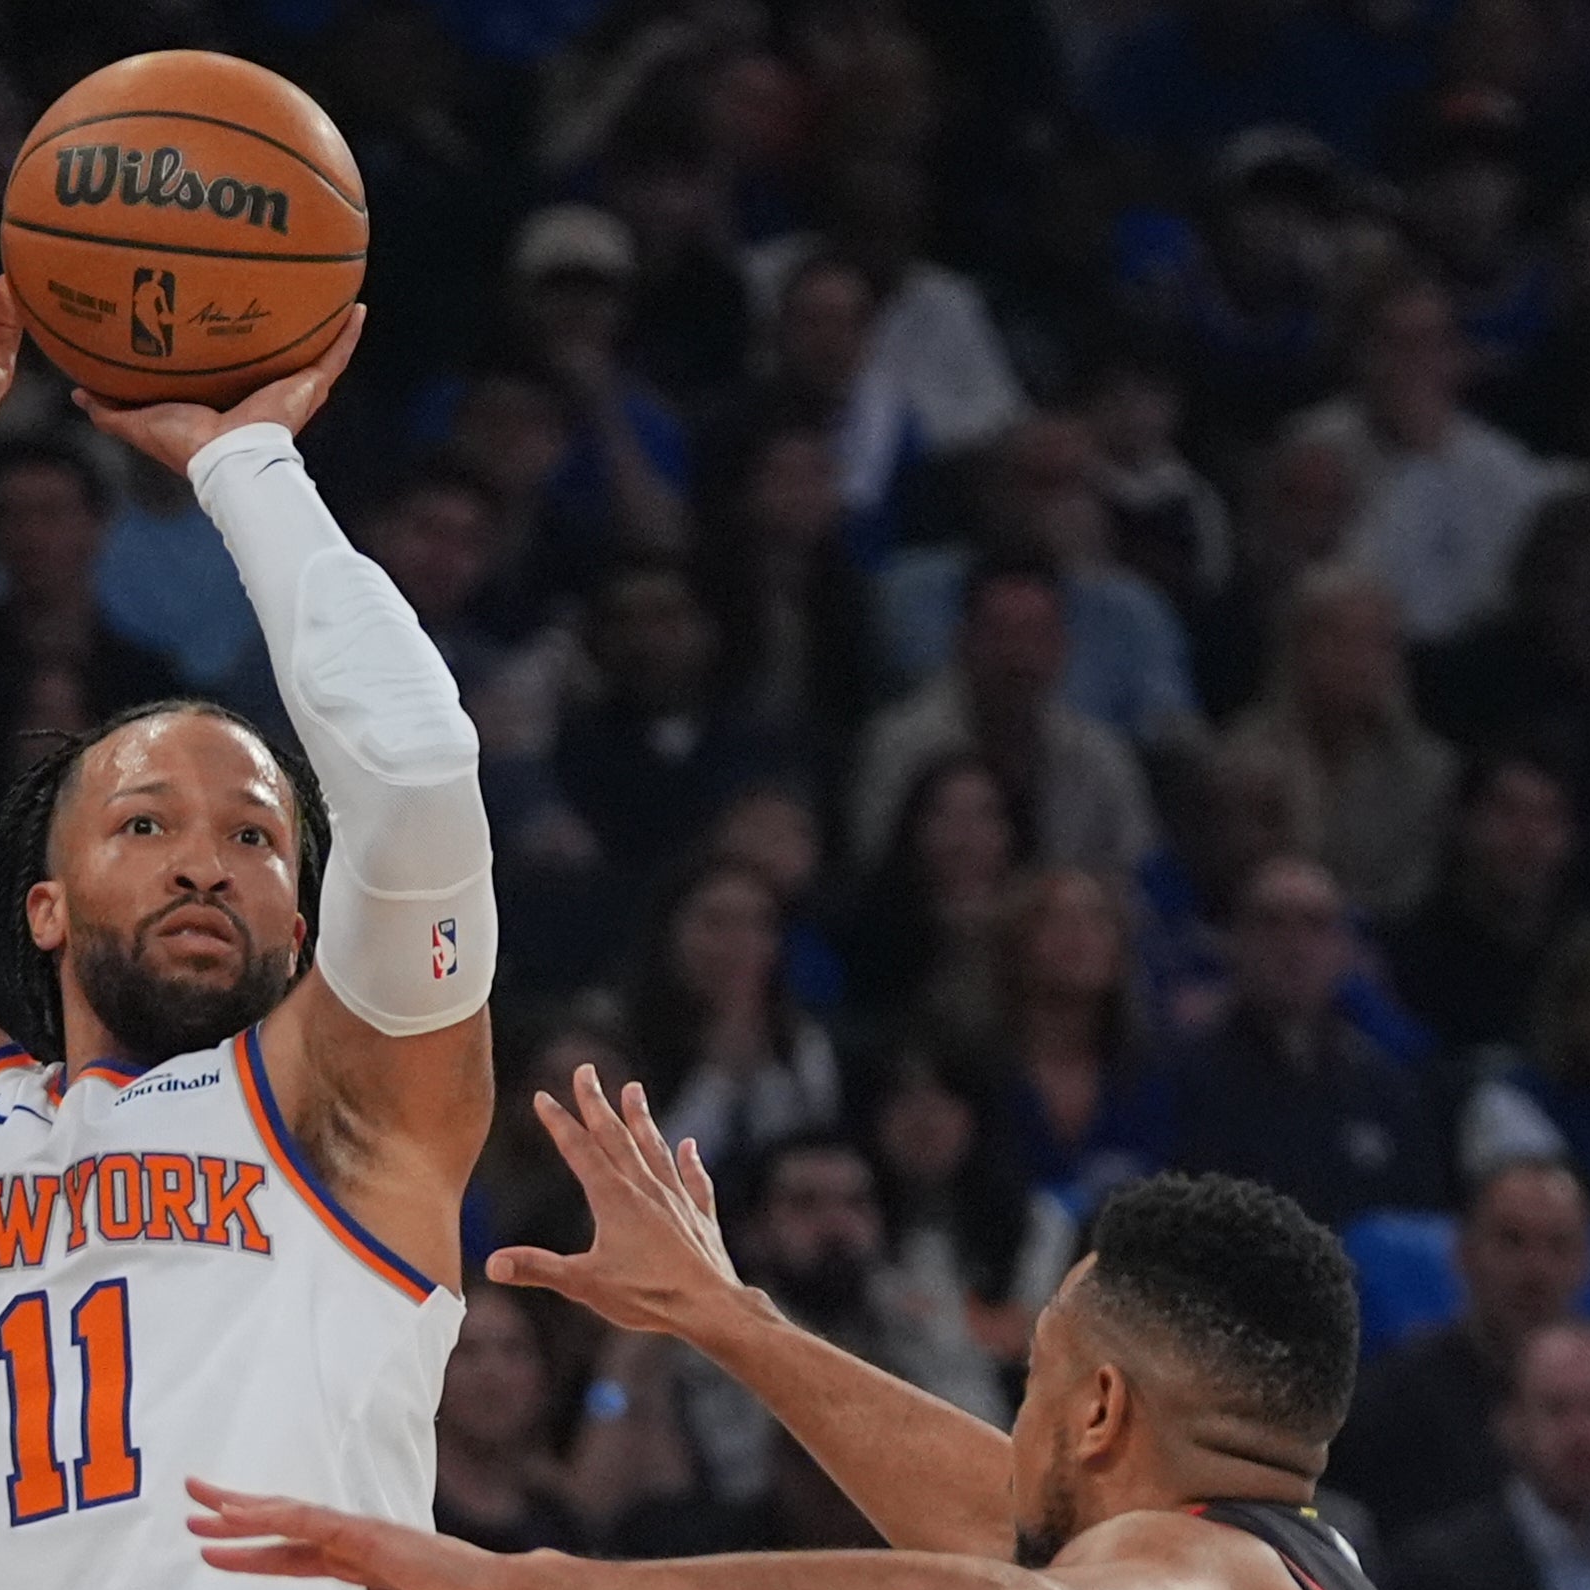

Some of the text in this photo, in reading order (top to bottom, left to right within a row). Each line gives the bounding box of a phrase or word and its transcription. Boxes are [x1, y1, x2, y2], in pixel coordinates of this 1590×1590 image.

[55, 144, 290, 236] Wilson
[114, 1086, 153, 1107] abu
[157, 1068, 221, 1093] dhabi
[65, 1152, 273, 1258] YORK
